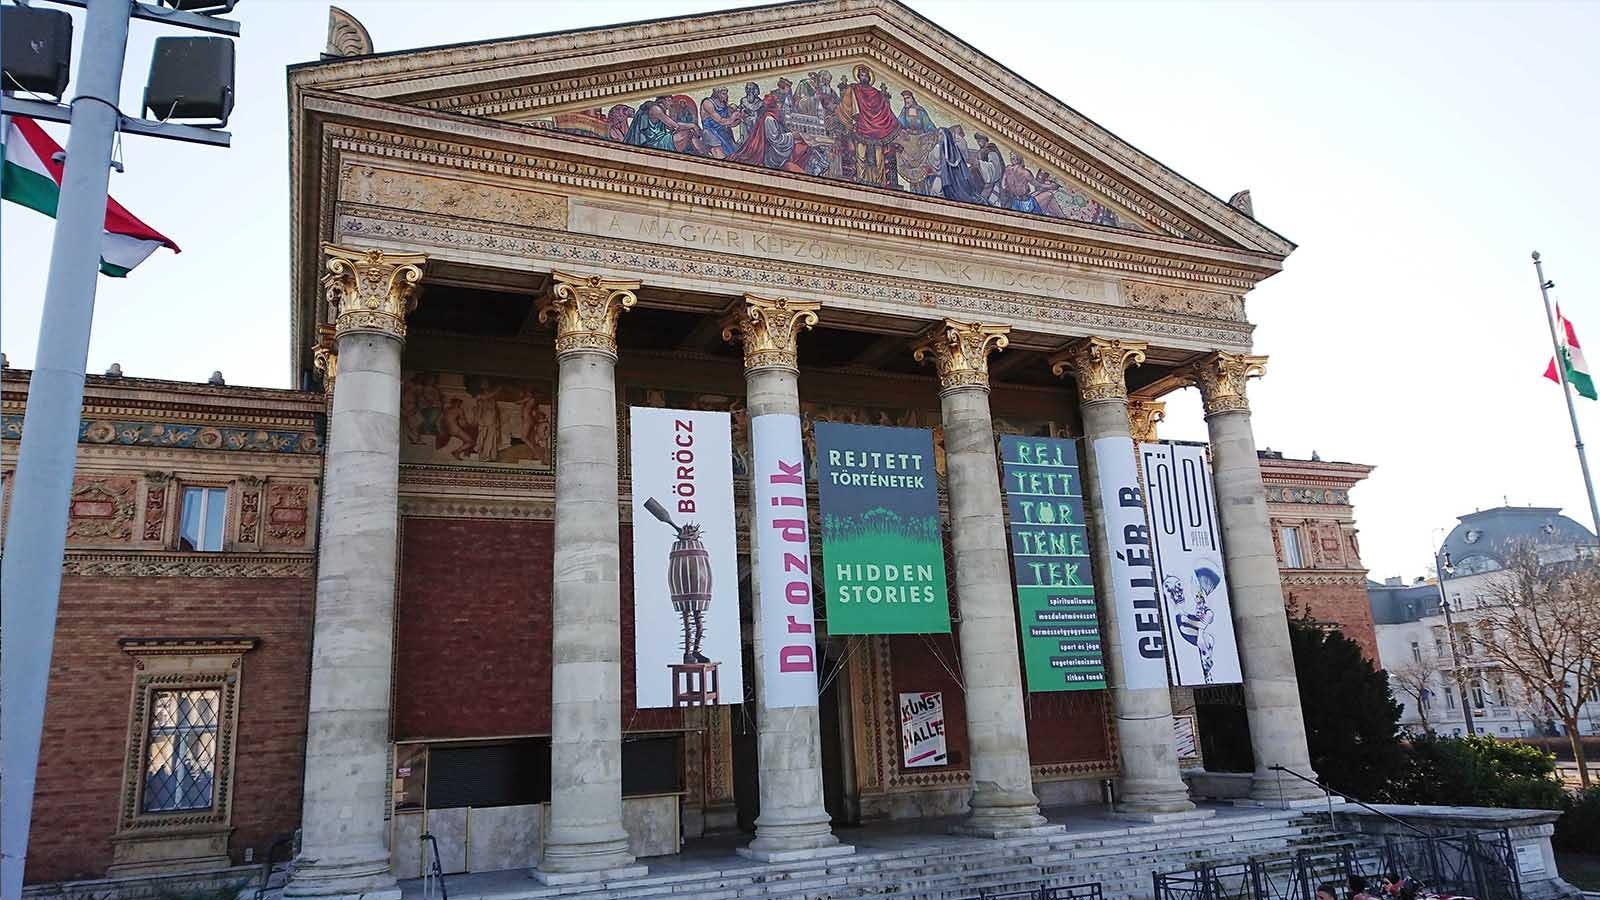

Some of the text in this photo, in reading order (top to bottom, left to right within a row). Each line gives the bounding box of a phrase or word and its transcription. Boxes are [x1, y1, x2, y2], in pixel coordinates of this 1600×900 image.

[608, 214, 622, 232] A
[637, 218, 743, 248] MAGYAR
[829, 450, 923, 470] REJTETT
[1017, 442, 1064, 465] REJ
[672, 419, 696, 514] BÖRÖCZ
[830, 469, 925, 489] TÖRTÉNETEK
[1011, 472, 1073, 496] TETT
[770, 459, 815, 673] Drozdik
[836, 564, 934, 582] HIDDEN
[1027, 562, 1080, 586] TEK
[838, 586, 935, 604] STORIES
[1116, 524, 1164, 659] GELLÉR
[902, 694, 941, 719] KUNST
